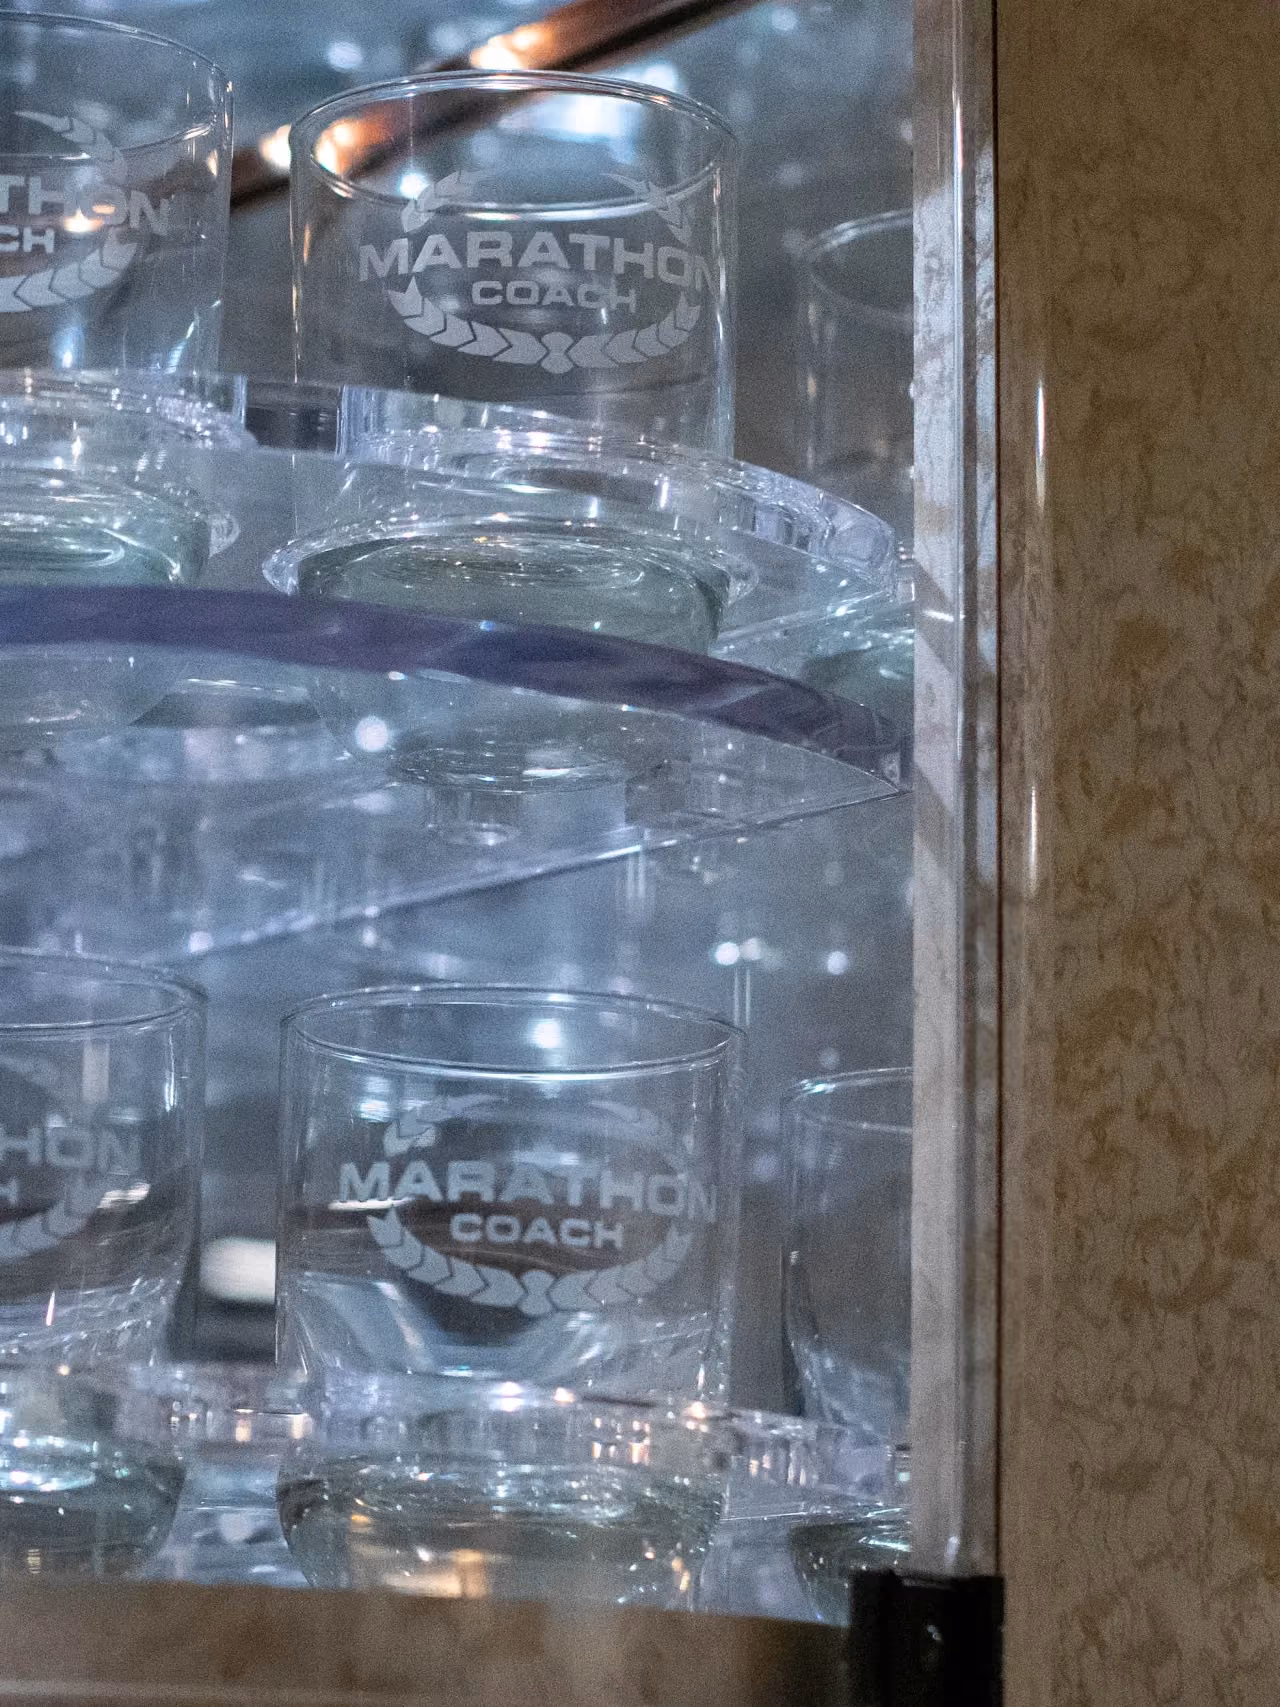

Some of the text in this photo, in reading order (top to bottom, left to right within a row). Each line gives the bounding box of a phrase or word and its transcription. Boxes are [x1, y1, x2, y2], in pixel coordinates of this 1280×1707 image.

[358, 231, 720, 303] MARATHON
[471, 280, 636, 313] COACH
[339, 1160, 717, 1222] MARATHON
[449, 1212, 624, 1249] COACH
